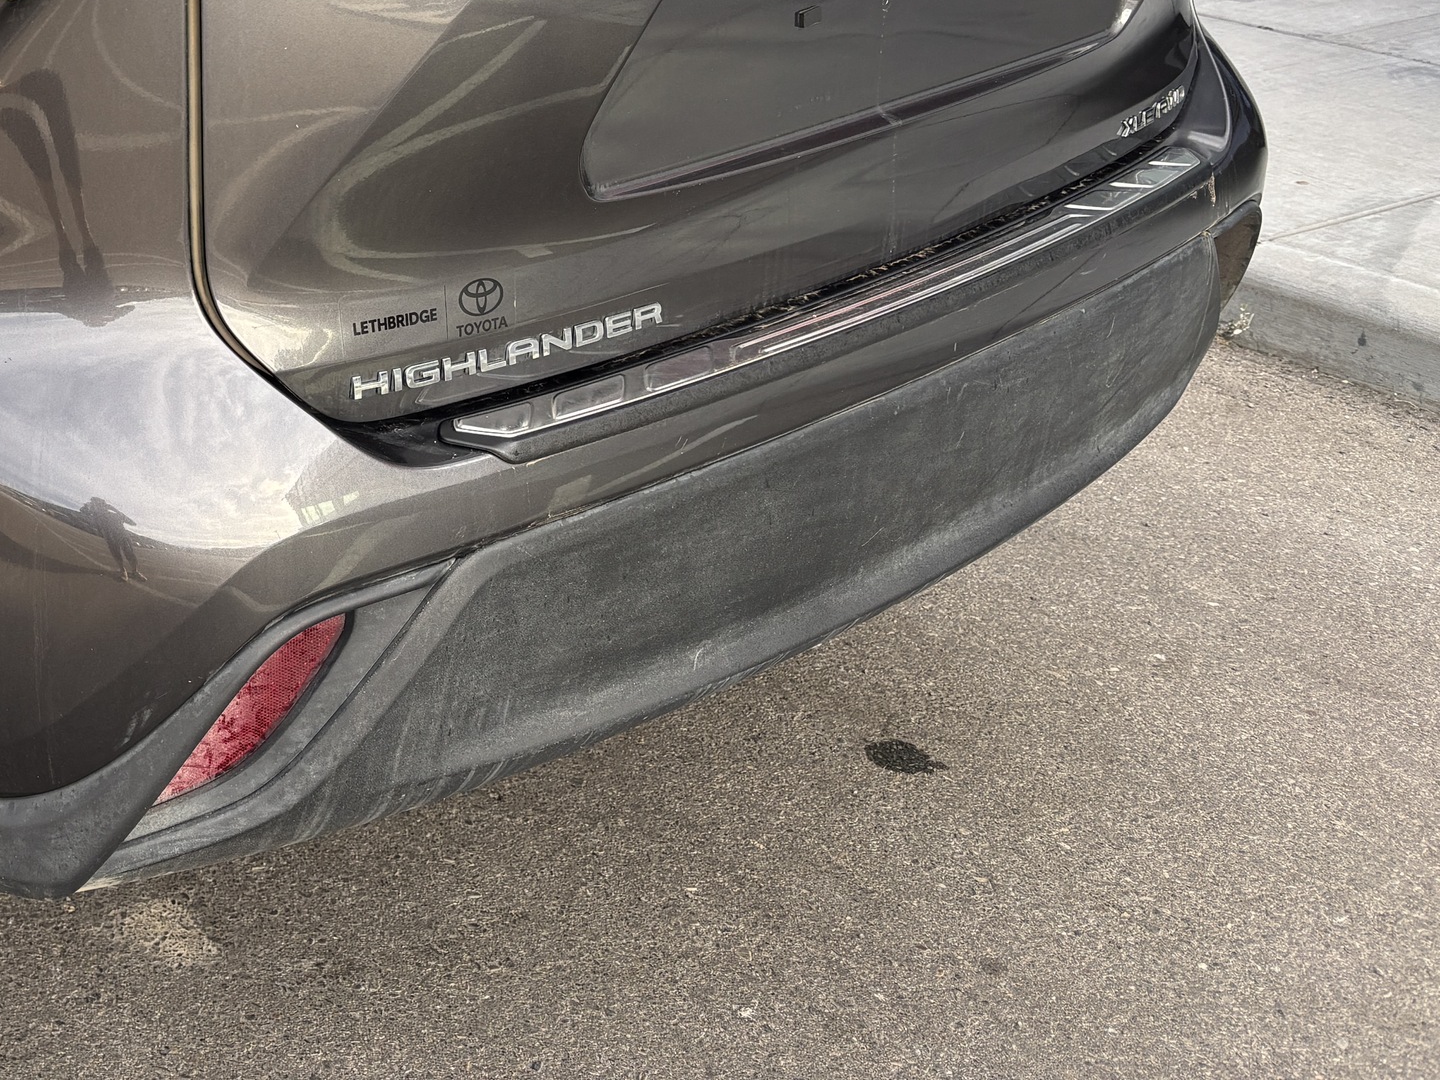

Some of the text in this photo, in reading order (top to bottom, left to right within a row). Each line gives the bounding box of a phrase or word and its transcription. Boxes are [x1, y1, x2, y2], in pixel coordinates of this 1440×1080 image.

[352, 308, 438, 337] LETHBRIDGE
[456, 316, 509, 338] TOYOTA
[348, 301, 664, 400] HIGHLANDER
